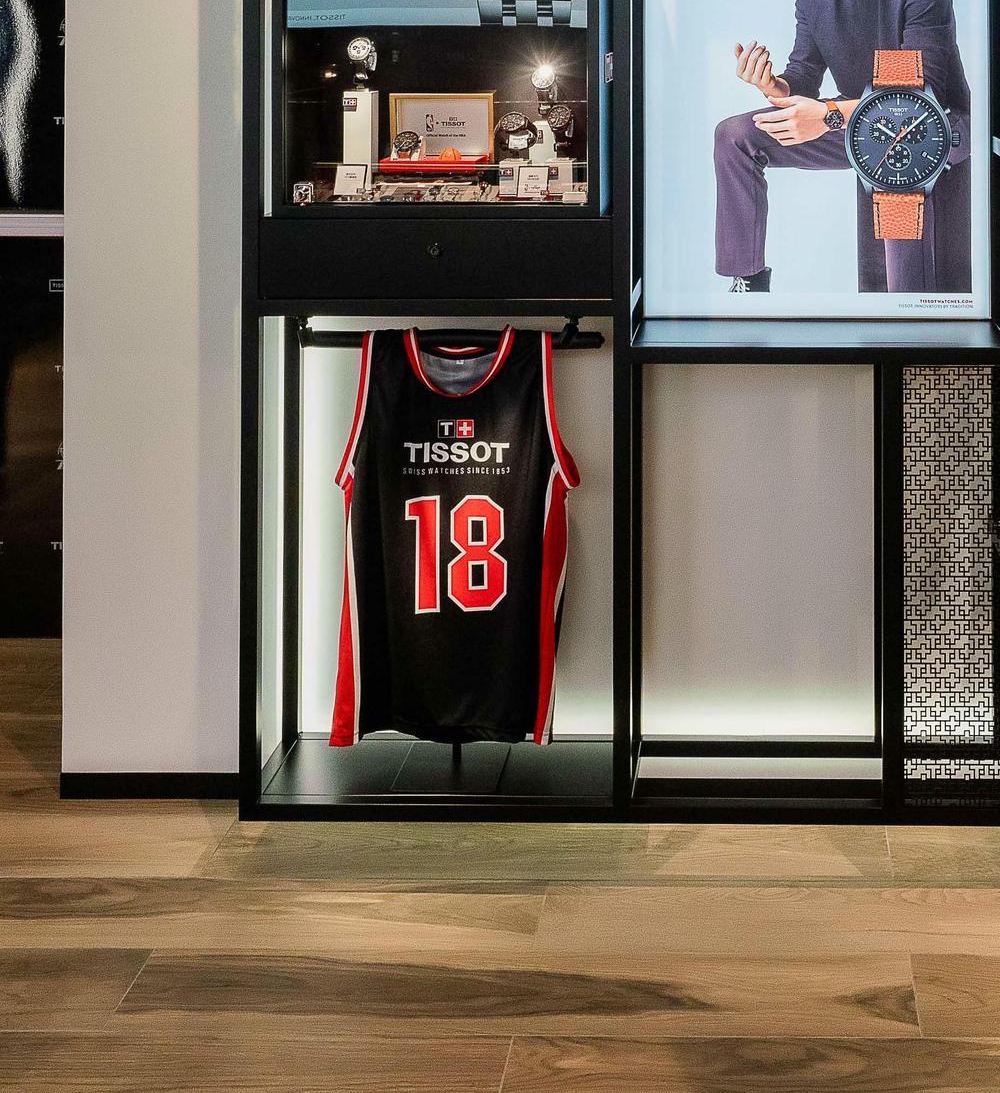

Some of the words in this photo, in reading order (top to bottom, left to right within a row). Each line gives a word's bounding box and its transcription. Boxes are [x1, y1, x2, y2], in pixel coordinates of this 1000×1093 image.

[440, 421, 454, 436] T
[403, 440, 510, 464] TISSOT
[428, 467, 465, 475] WATCHES
[466, 466, 489, 475] SINCE
[492, 466, 511, 475] 1853
[404, 494, 508, 615] 18
